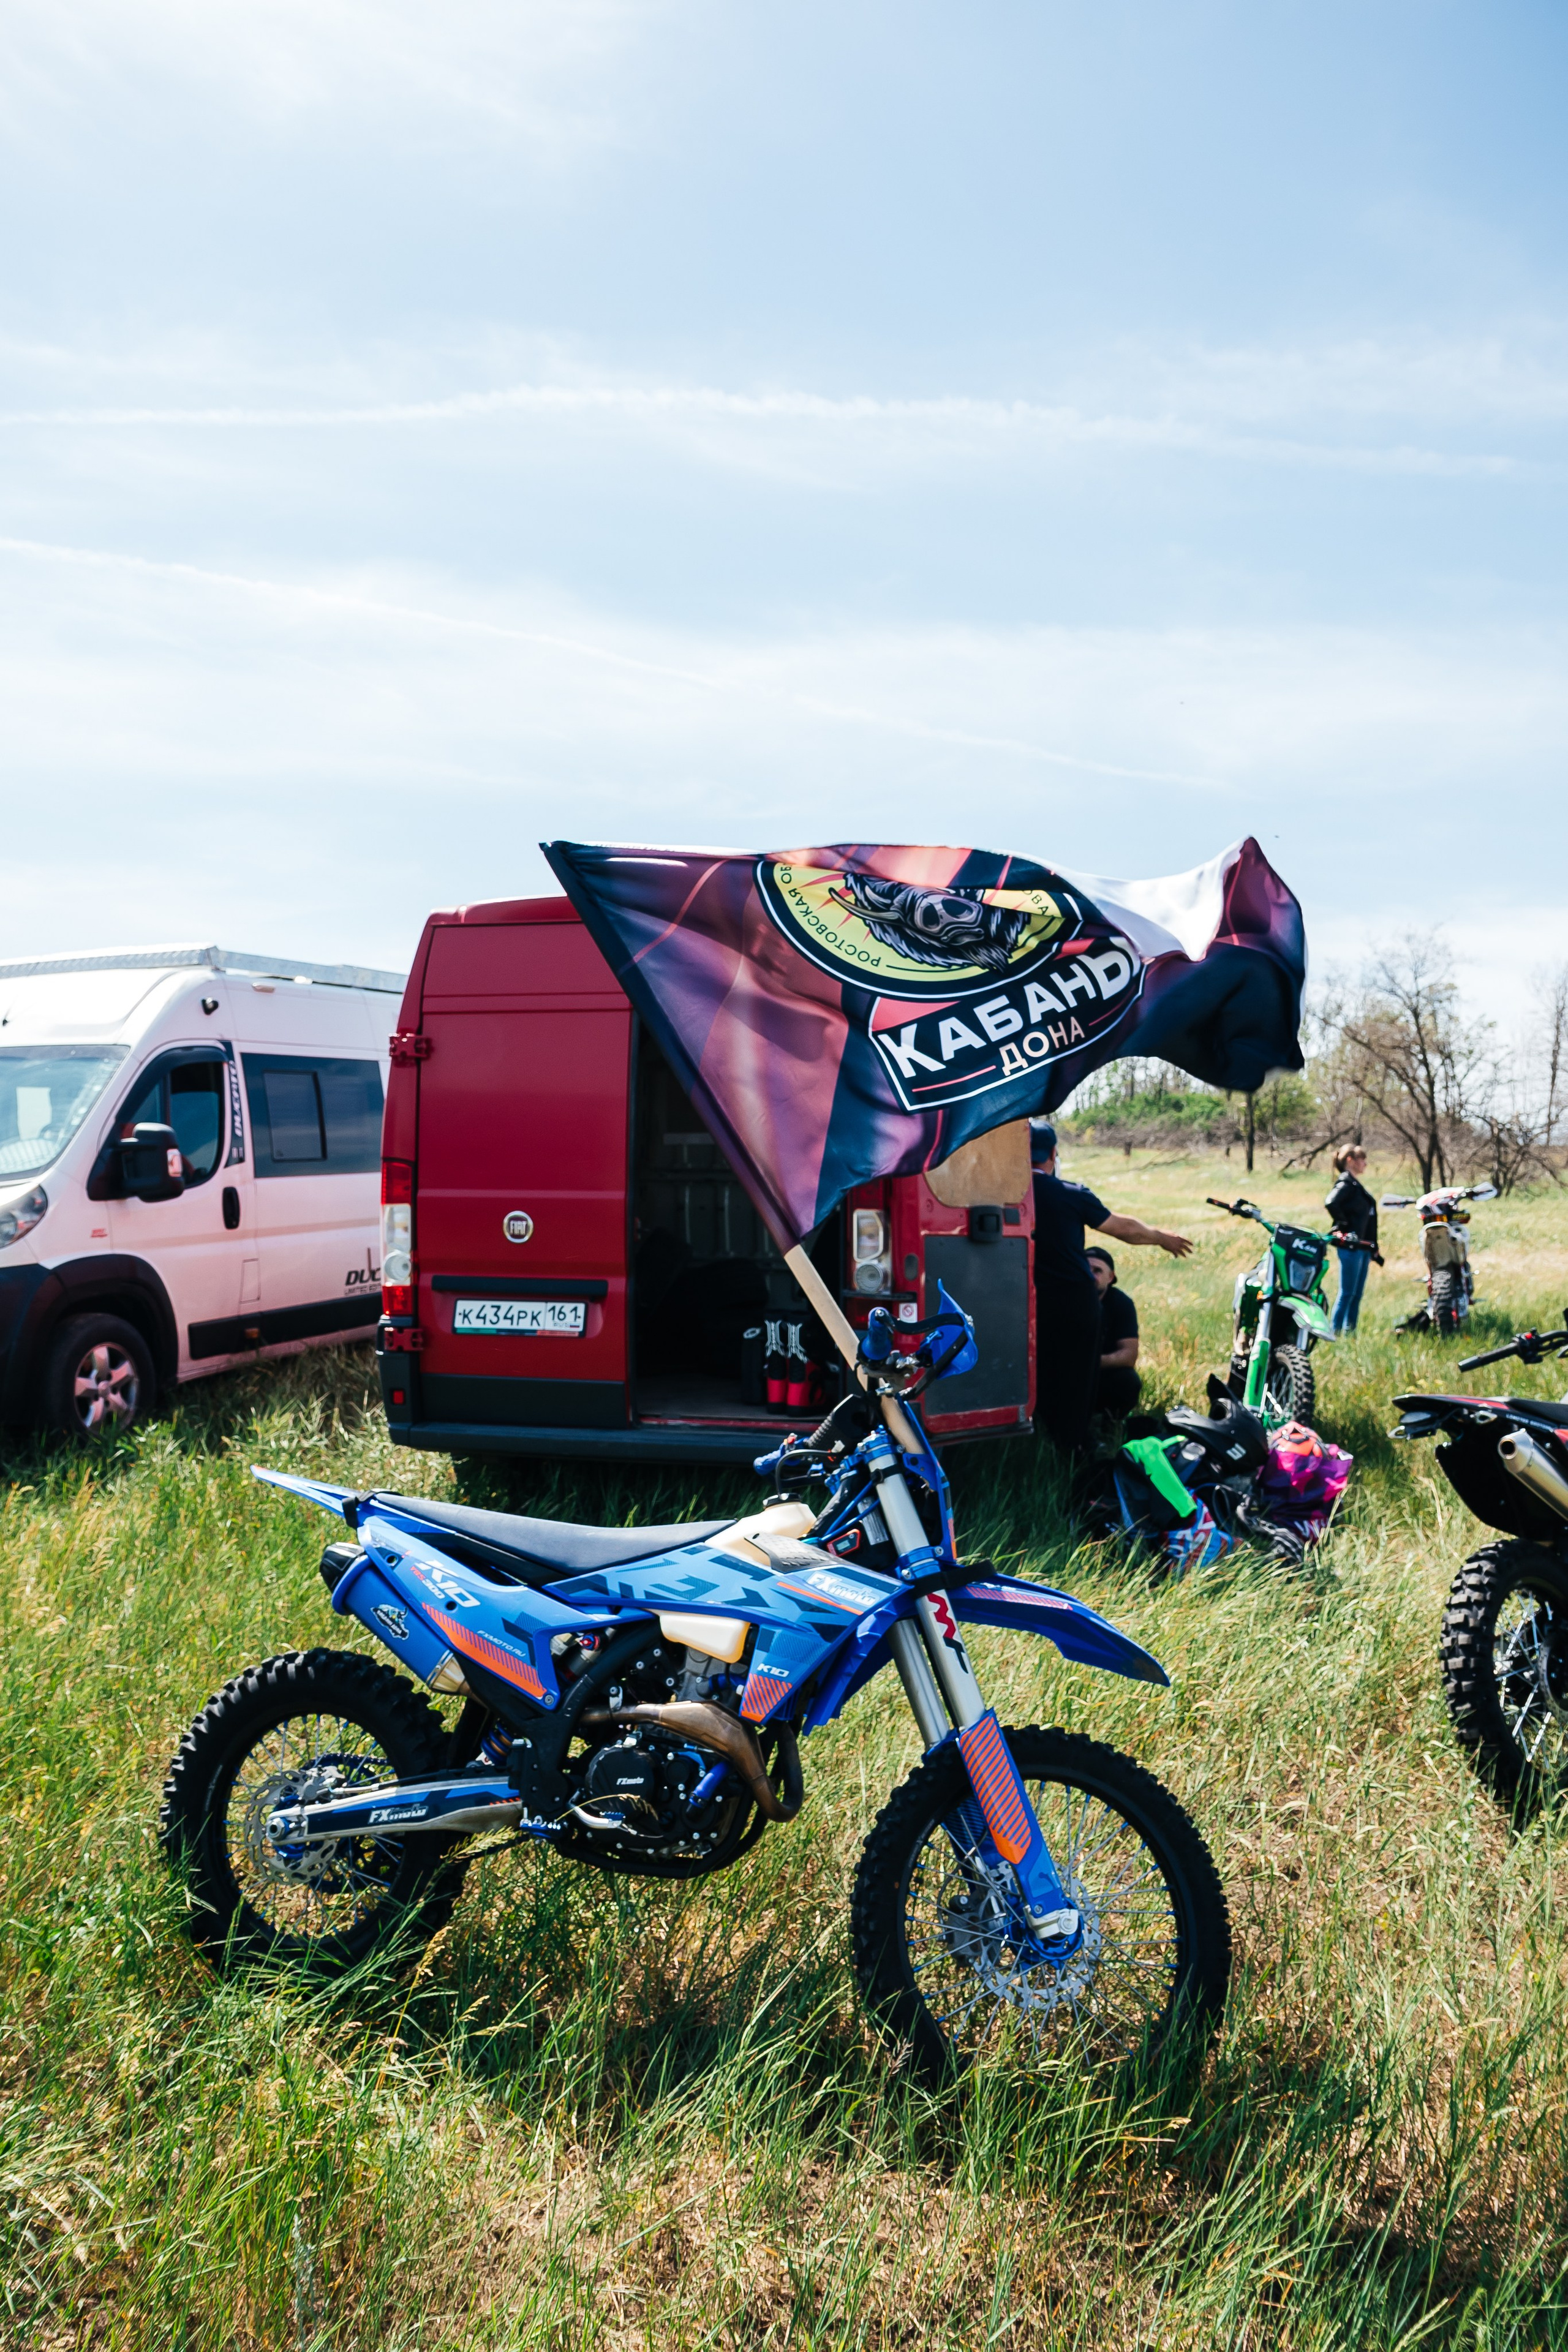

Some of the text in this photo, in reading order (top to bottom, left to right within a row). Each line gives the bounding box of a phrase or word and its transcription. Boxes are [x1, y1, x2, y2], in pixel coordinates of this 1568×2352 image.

[788, 888, 881, 967] РОСТОВСКАЯ
[999, 1016, 1085, 1076] ДОНА
[509, 1220, 527, 1235] FIAT
[462, 1304, 578, 1327] К434РК 161
[756, 1663, 790, 1678] K10
